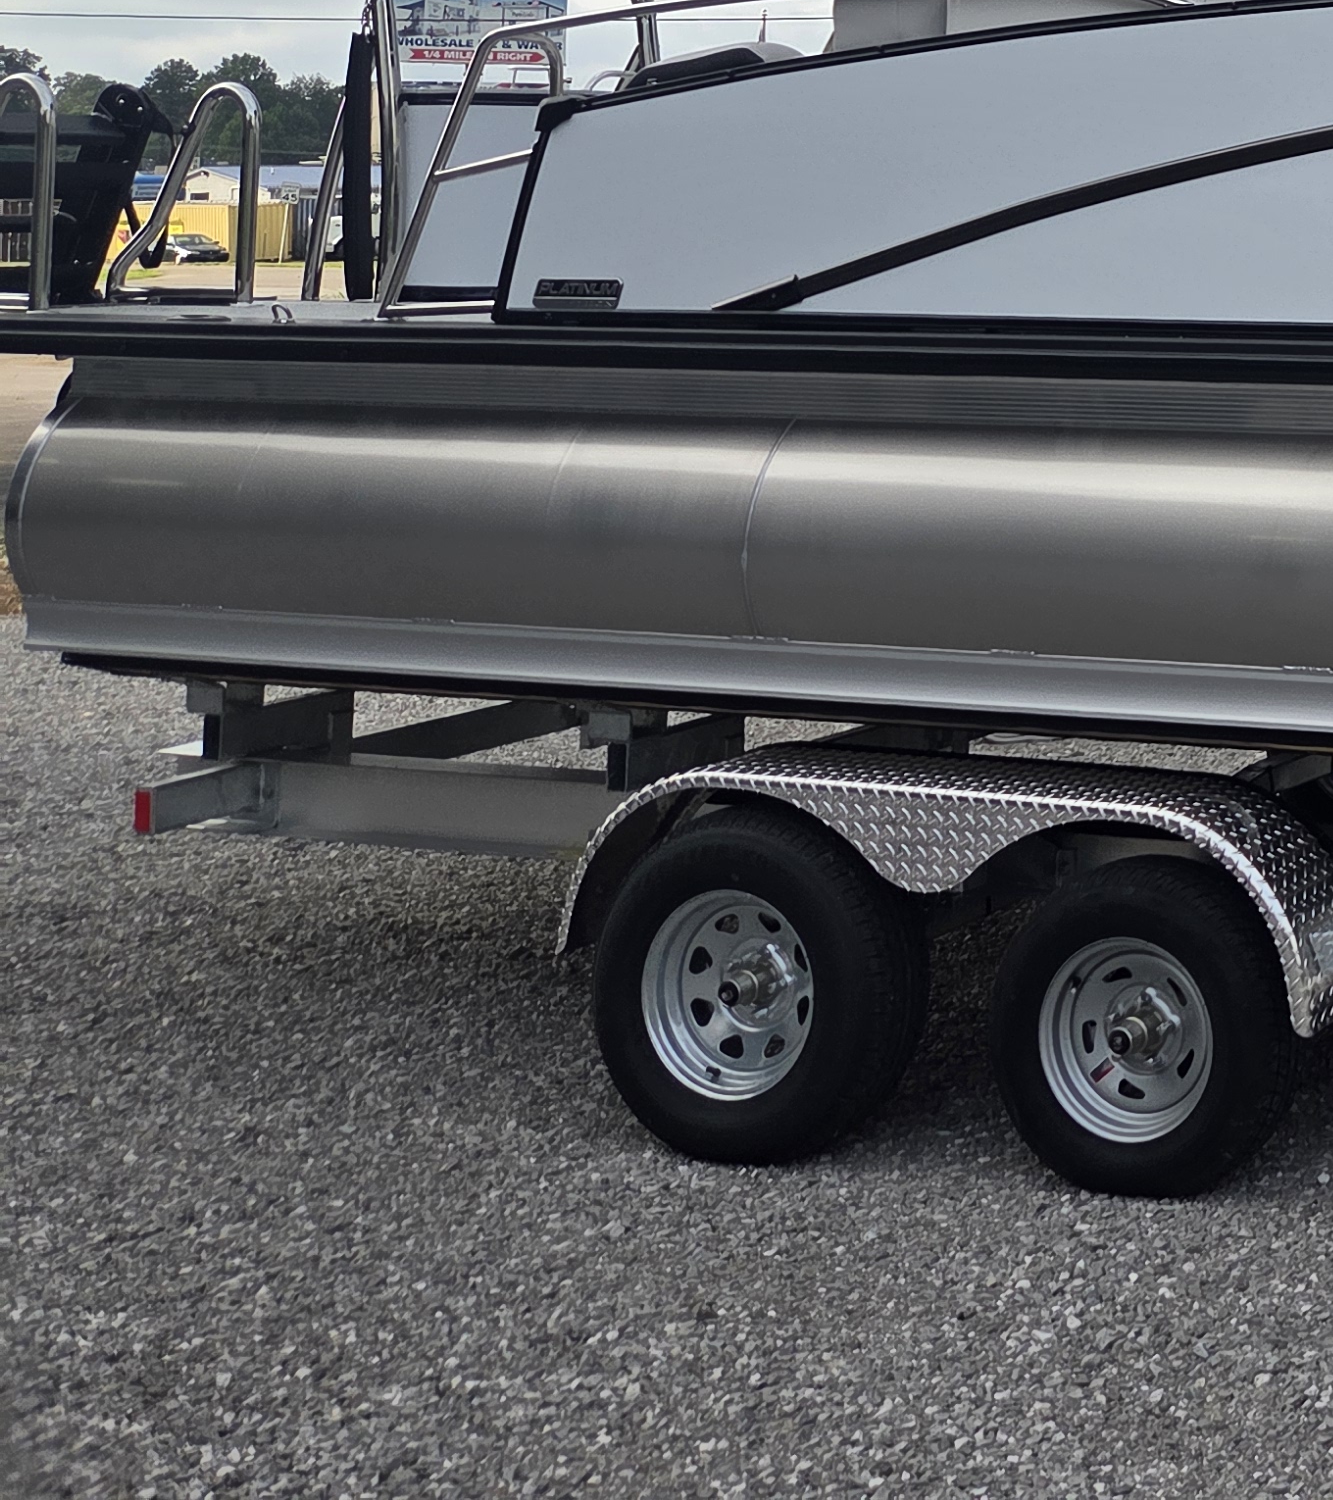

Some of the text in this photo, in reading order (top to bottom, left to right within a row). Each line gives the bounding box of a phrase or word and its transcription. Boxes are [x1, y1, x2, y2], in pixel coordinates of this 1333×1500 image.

[502, 39, 511, 49] &
[517, 40, 563, 50] WAR
[423, 50, 441, 58] 1/4
[497, 52, 533, 61] RIGHT
[282, 193, 298, 202] 45
[539, 282, 619, 295] PLATINUM
